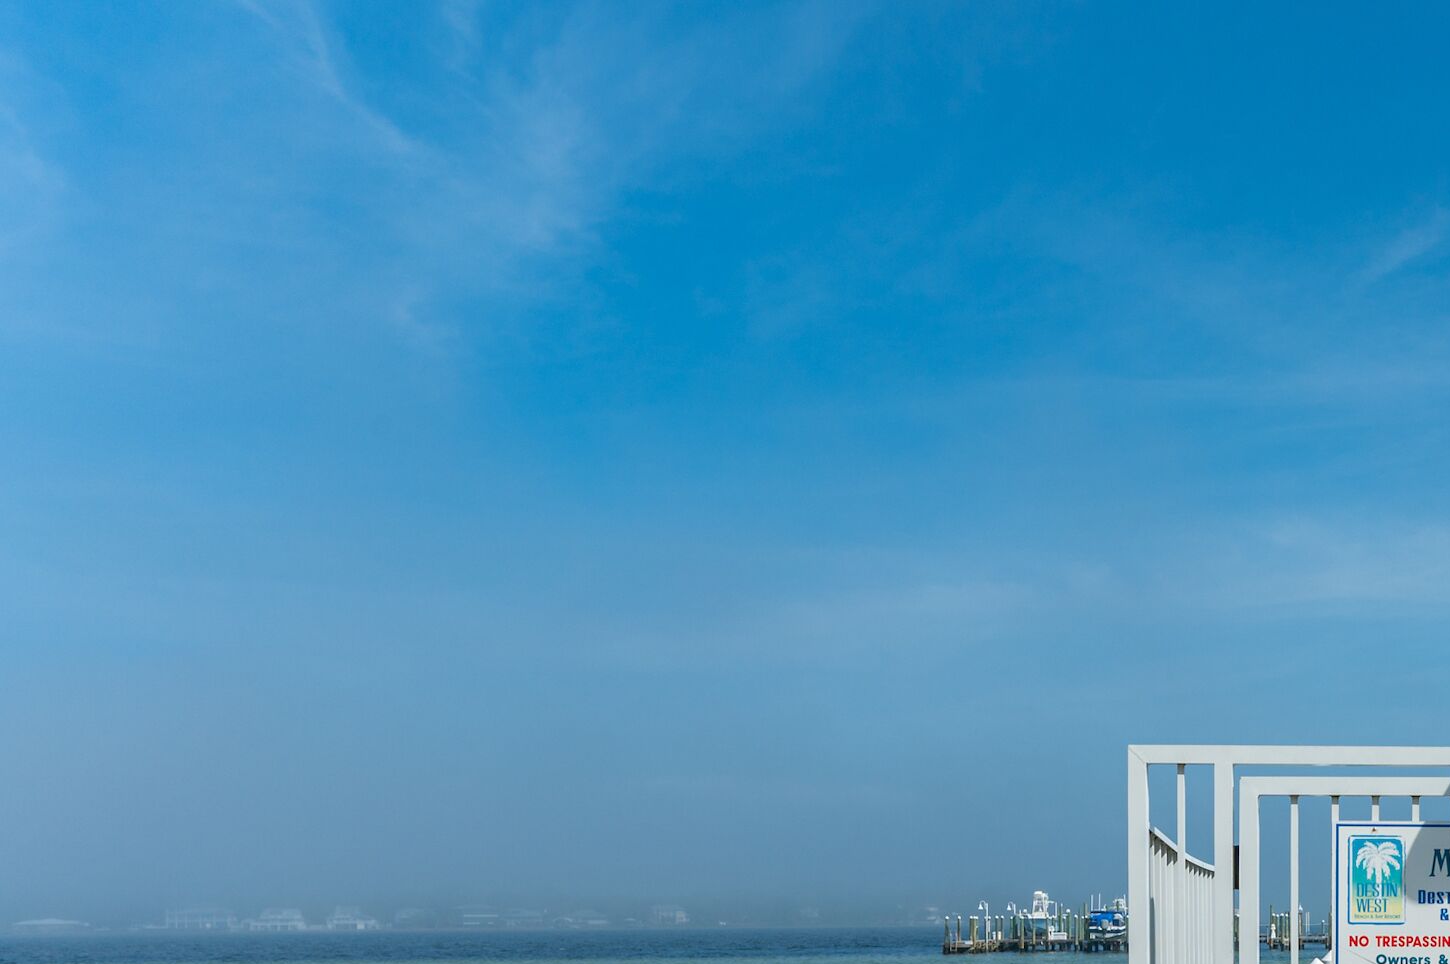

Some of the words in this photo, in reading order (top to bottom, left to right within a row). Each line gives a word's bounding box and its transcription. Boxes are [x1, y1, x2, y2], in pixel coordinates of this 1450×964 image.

[1356, 898, 1388, 913] WEST
[1440, 908, 1449, 921] &
[1349, 936, 1369, 947] NO
